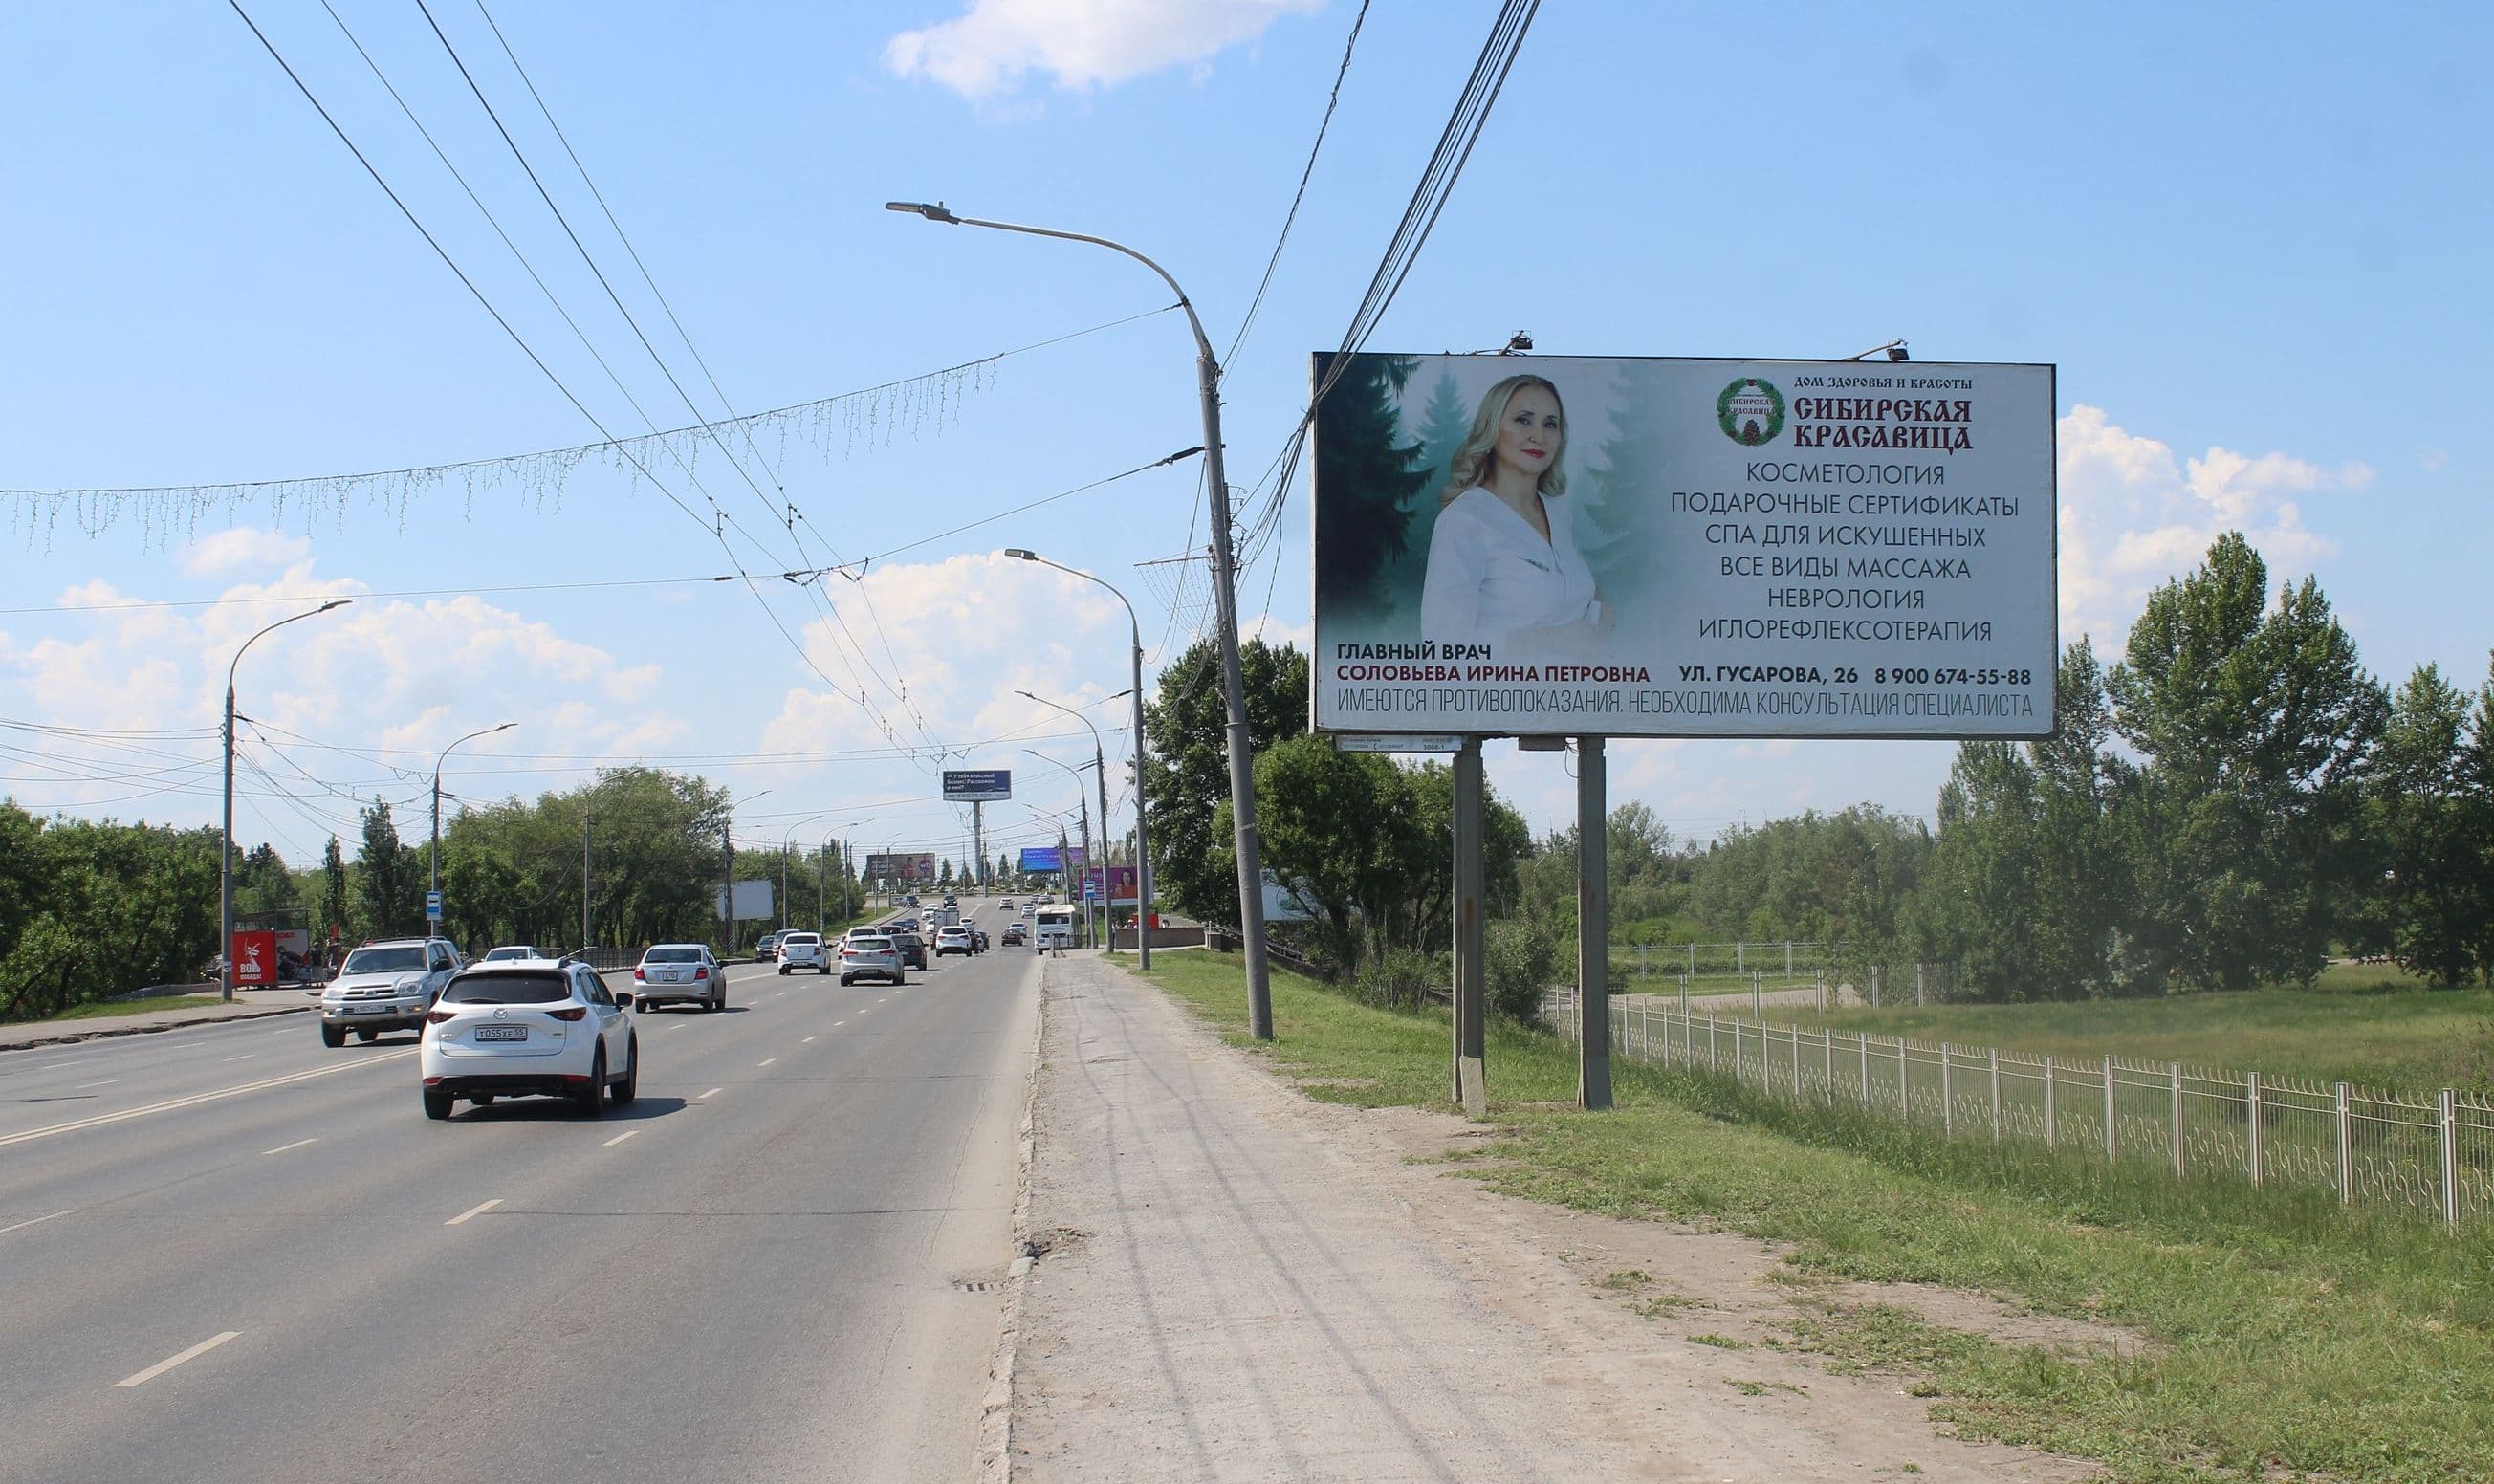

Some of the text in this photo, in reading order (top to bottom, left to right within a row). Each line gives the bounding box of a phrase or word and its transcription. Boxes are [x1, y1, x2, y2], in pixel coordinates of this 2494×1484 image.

[1795, 377, 1972, 389] ДОМ ЗДОРОВЬЯ И КРАСОТЫ
[1795, 398, 1972, 422] СИБИРСКАЯ
[1794, 425, 1973, 454] КРАСАВИЦА
[1748, 463, 1943, 484] КОСМЕТОЛОГИЯ
[1673, 492, 2018, 516] ПОДАРОЧНЫЕ СЕРТИФИКАТЫ
[1706, 524, 1985, 548] СПА ДЛЯ ИСКУШЕННЫХ
[1722, 556, 1971, 579] ВСЕ ВИДЫ МАССАЖА
[1769, 589, 1923, 609] НЕВРОЛОГИЯ
[1700, 620, 1990, 641] ИГЛОРЕФЛЕКСОТЕРАПИЯ
[1338, 641, 1491, 660] ГЛАВНЫЙ ВРАЧ
[1337, 666, 1650, 682] СОЛОВЬЕВА ИРИНА ПЕТРОВНА
[1679, 666, 1858, 686] УЛ. ГУСАРОВА, 26
[1875, 668, 2031, 685] 8 900 674-55-88
[1339, 688, 2032, 717] ИМЕЮТСЯ ПРОТИВОПОКАЗАНИЯ. НЕОБХОДИМА КОНСУЛЬТАЦИЯ СПЕЦИАЛИСТА
[240, 963, 252, 973] 80
